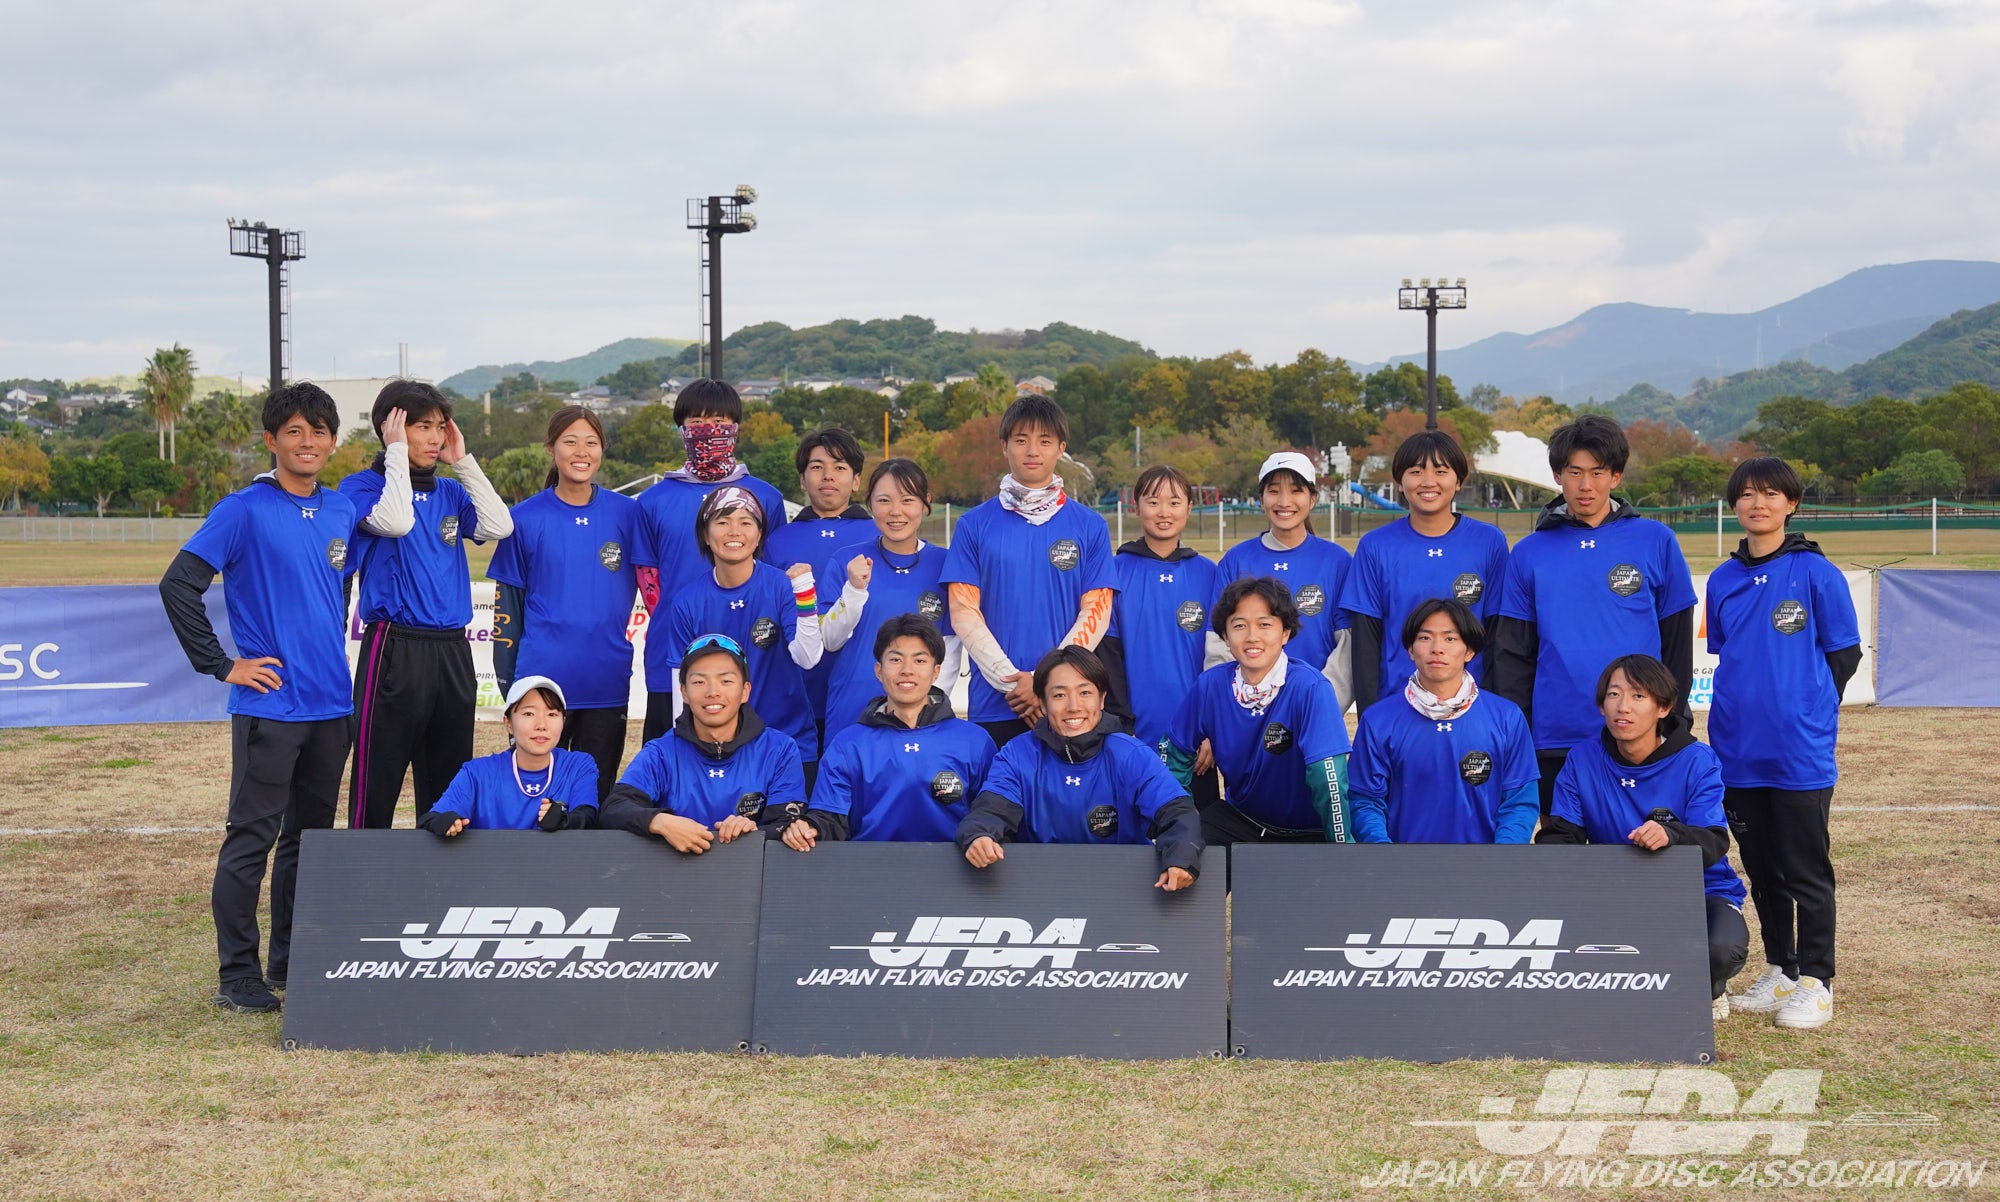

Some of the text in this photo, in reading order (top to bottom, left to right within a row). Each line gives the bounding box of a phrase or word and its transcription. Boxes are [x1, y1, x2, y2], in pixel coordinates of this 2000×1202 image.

[473, 603, 495, 611] ame
[400, 907, 620, 959] JFDA
[868, 917, 1087, 968] JFDA
[1344, 918, 1564, 969] JFDA
[325, 961, 719, 980] JAPAN FLYING DISC ASSOCIATION
[796, 969, 1188, 989] JAPAN FLYING DISC ASSOCIATION
[1272, 970, 1671, 991] JAPAN FLYING DISC ASSOCIATION
